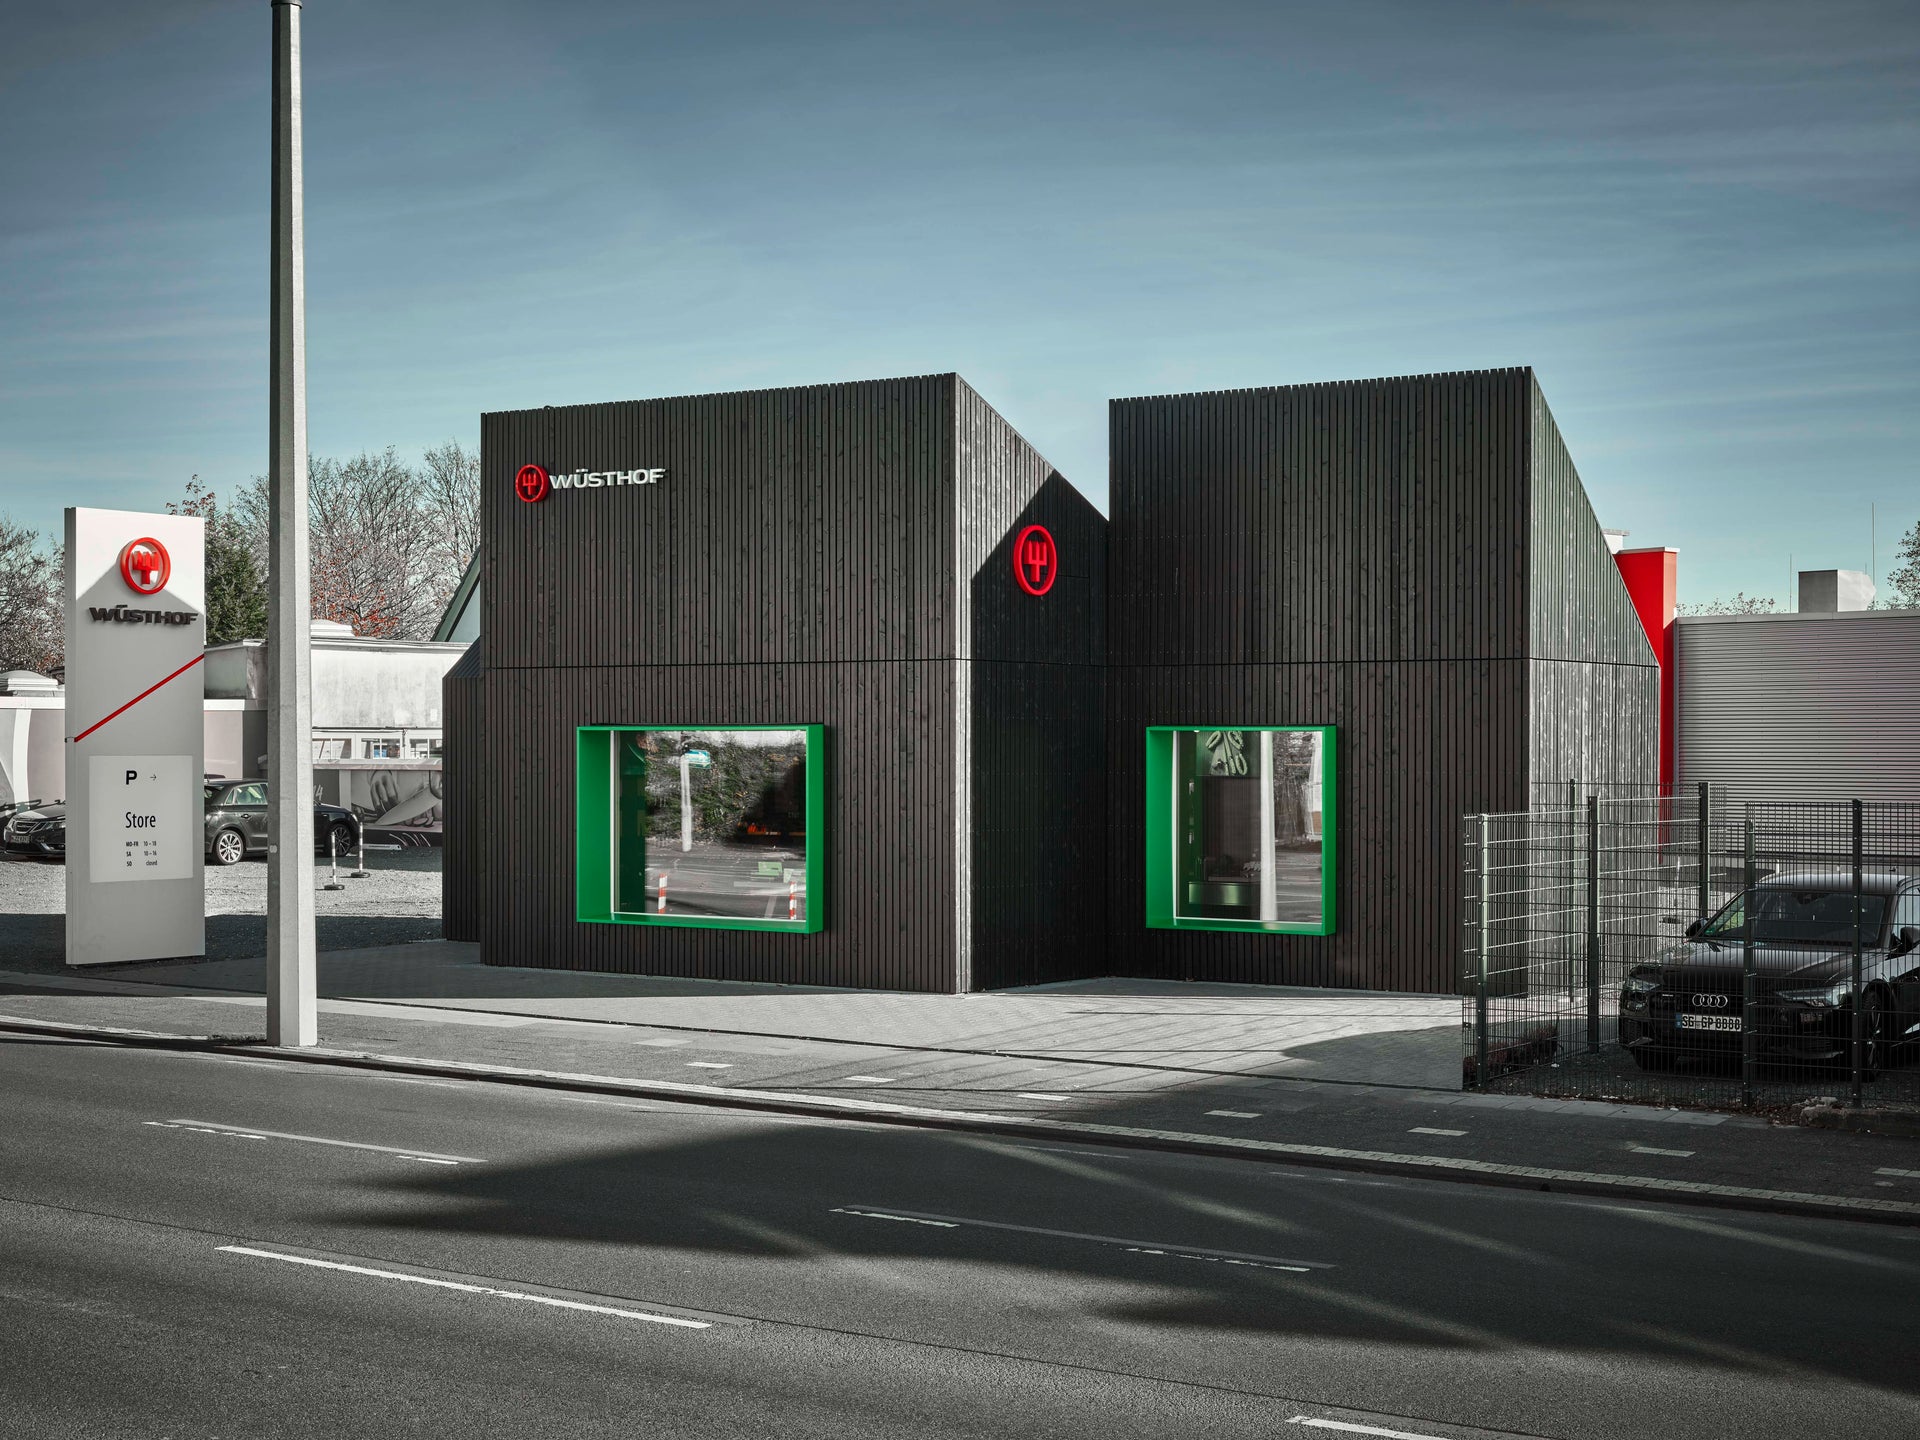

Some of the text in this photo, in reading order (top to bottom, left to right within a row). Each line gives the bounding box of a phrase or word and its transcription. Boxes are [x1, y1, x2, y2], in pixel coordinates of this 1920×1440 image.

[549, 468, 666, 490] WÜSTHOF
[89, 604, 199, 626] WÜSTHOF
[125, 770, 138, 785] P
[125, 811, 156, 829] Store
[1682, 1015, 1695, 1027] SG
